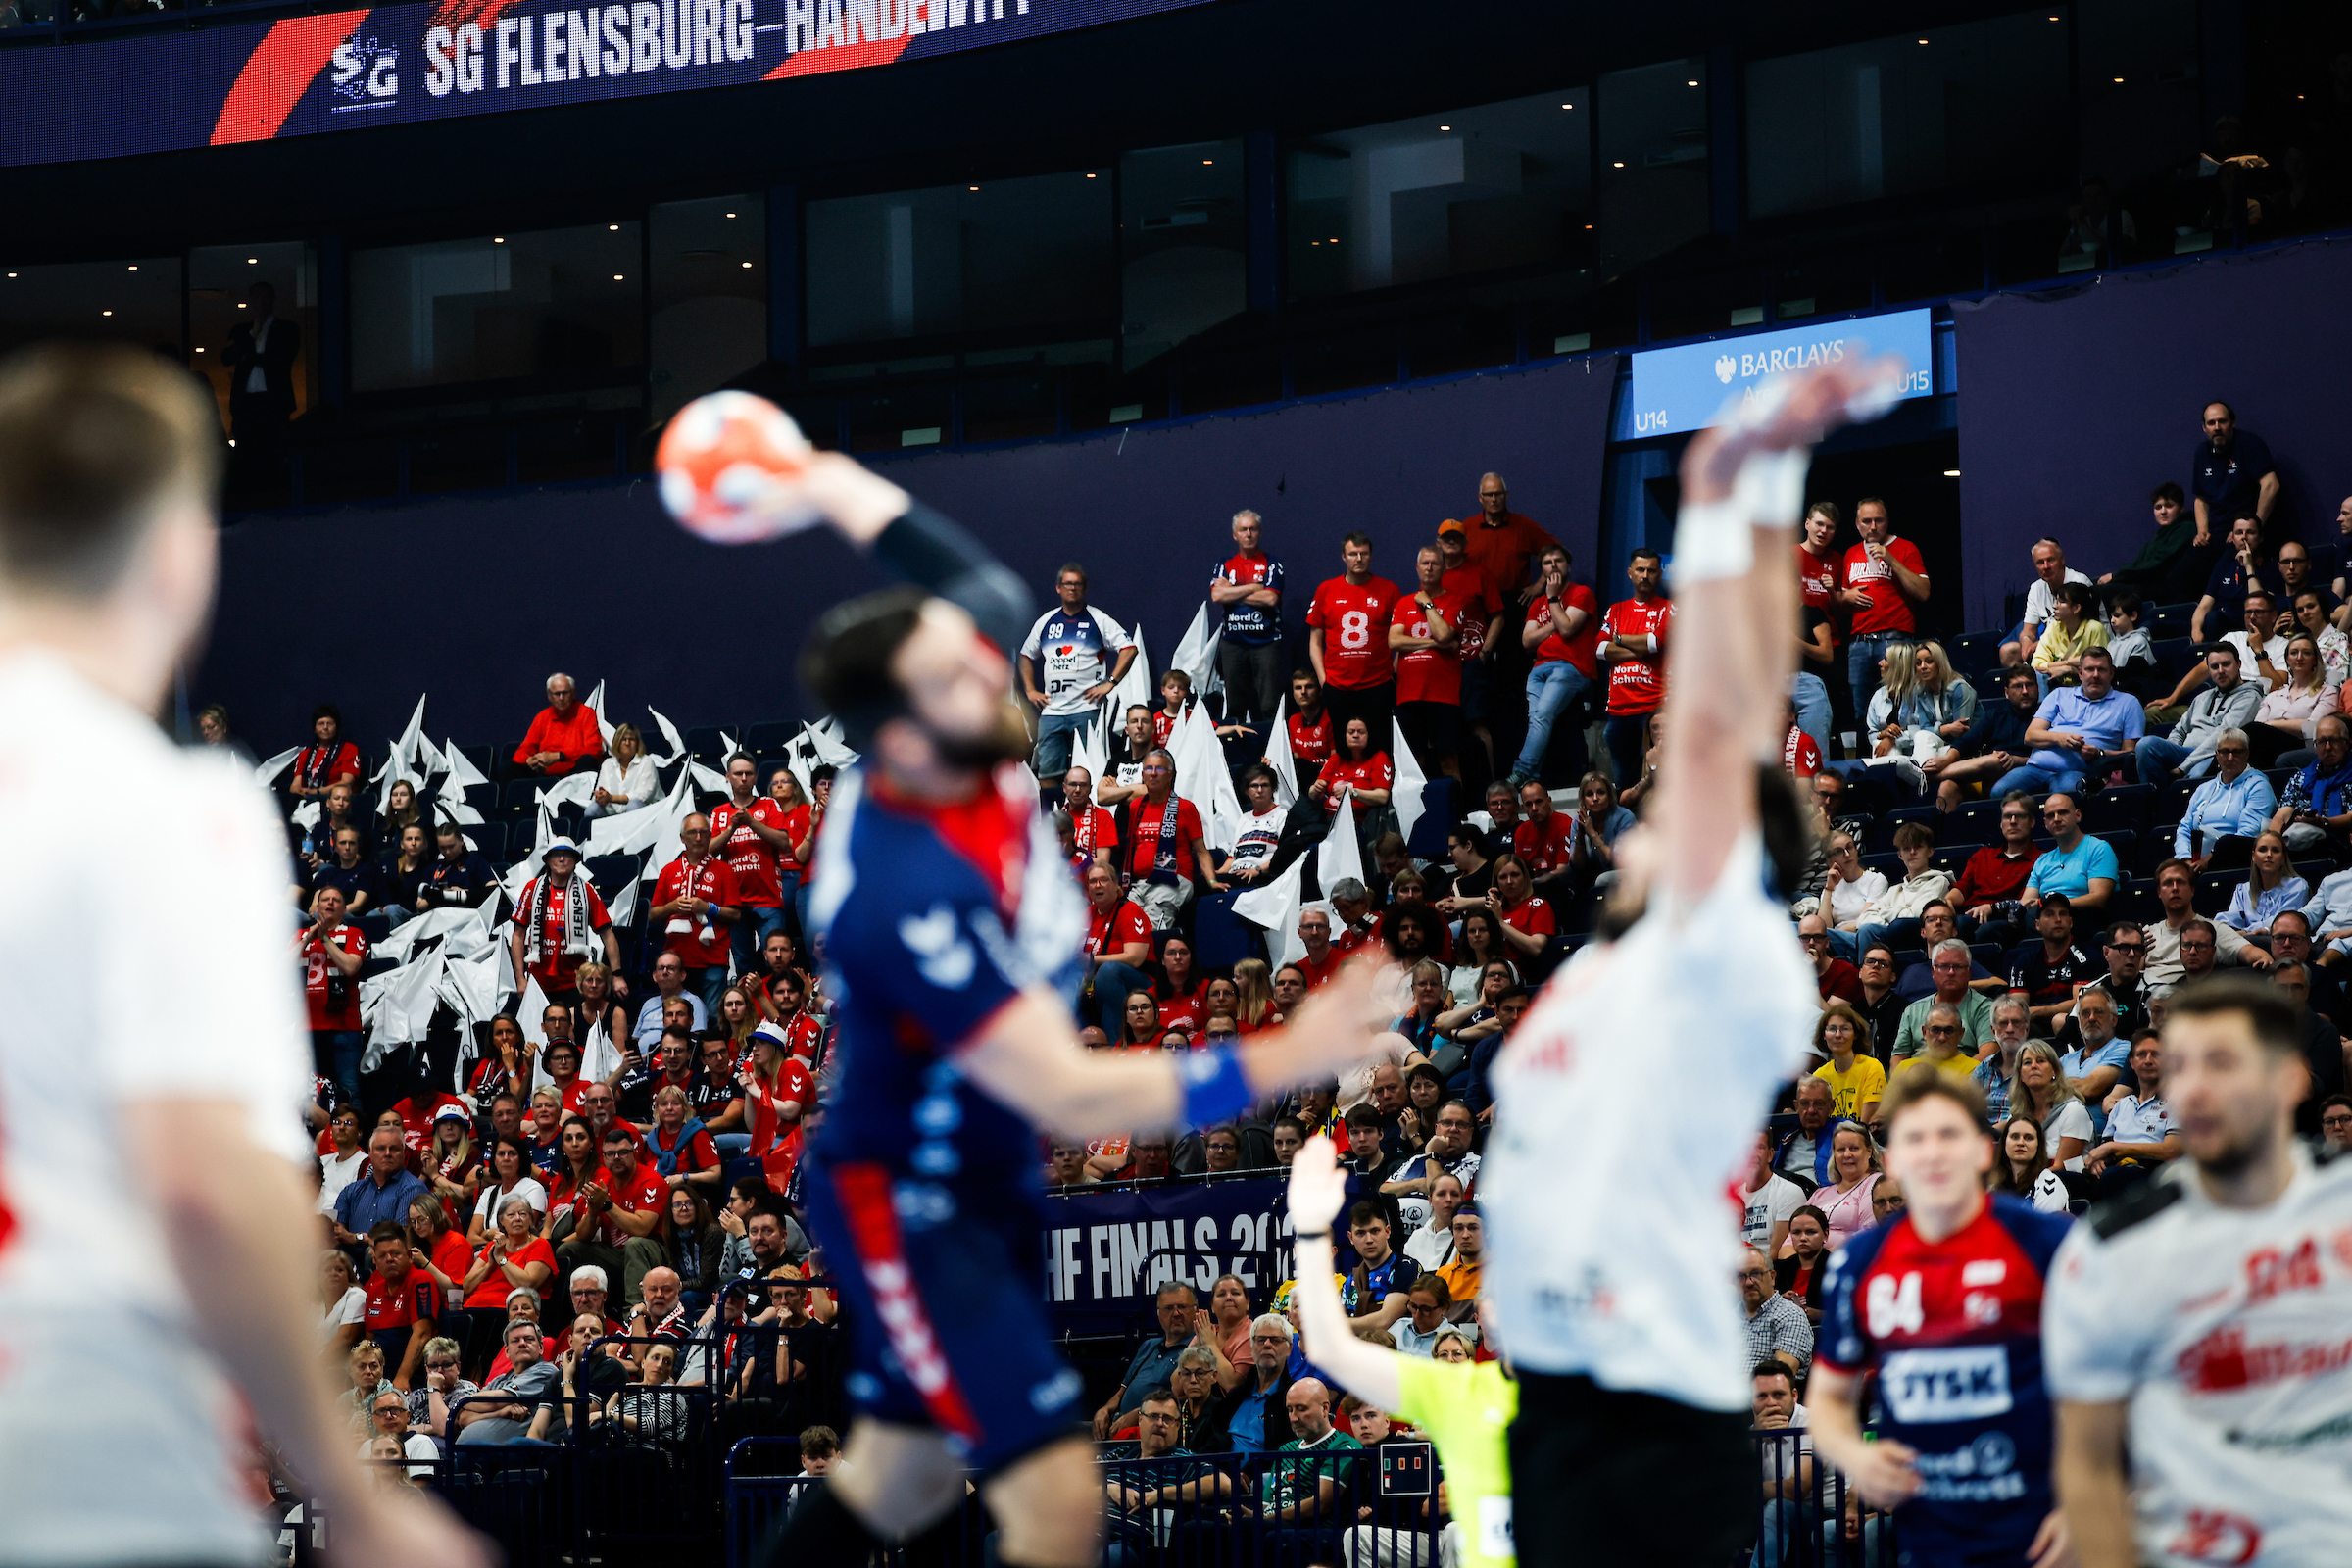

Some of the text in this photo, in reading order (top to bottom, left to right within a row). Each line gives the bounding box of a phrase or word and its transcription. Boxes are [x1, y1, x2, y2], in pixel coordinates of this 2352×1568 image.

[424, 22, 485, 98] SG
[1740, 339, 1844, 378] BARCLAYS
[1896, 369, 1930, 393] U15
[1635, 410, 1668, 432] U14
[1227, 612, 1251, 622] Nord
[1047, 622, 1065, 640] 99
[1227, 622, 1265, 632] Schrott
[1340, 610, 1369, 650] 8
[1049, 656, 1077, 665] Doppel
[1613, 664, 1640, 675] Nord
[1612, 673, 1654, 685] Schrott
[718, 811, 728, 828] 9
[732, 863, 761, 873] hrott
[1040, 1227, 1082, 1302] HF
[1090, 1215, 1220, 1299] FINALS
[1866, 1270, 1925, 1340] 64
